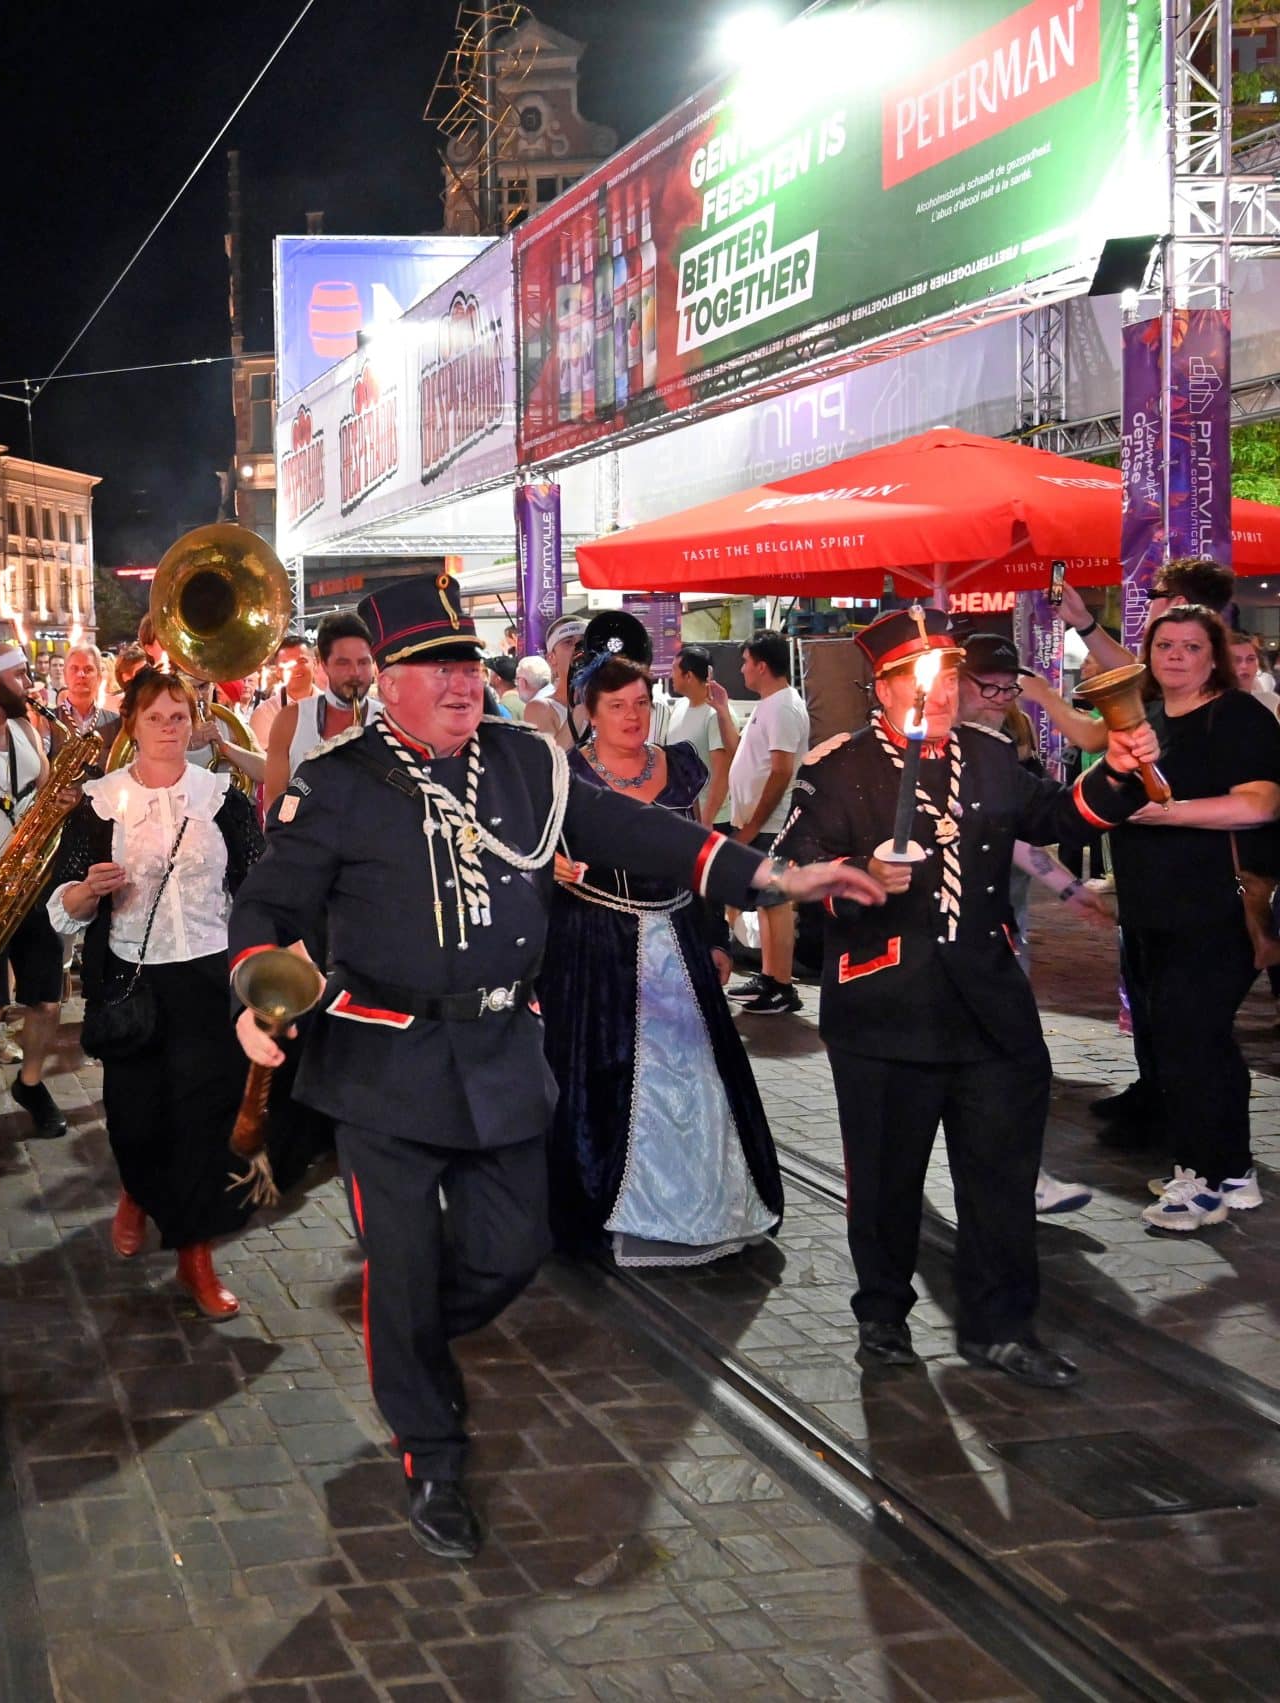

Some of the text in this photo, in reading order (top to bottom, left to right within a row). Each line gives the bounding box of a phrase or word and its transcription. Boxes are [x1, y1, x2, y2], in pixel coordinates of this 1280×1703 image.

[896, 5, 1076, 161] PETERMAN
[701, 110, 847, 232] FEESTEN IS
[915, 182, 967, 215] Alcoholmisbruik
[967, 167, 995, 190] schaadt
[995, 164, 1005, 177] de
[931, 205, 952, 223] L'abus
[953, 191, 980, 213] d'alcool
[980, 185, 995, 201] nuit
[1001, 180, 1009, 190] la
[681, 220, 768, 299] BETTER
[930, 245, 1019, 291] #BETTERTOGETHER
[684, 248, 811, 342] TOGETHER
[852, 280, 928, 322] #BETTERTOGETHER
[1132, 412, 1147, 484] Gentse
[683, 534, 866, 562] TASTE THE BELGIAN SPIRIT
[949, 591, 1017, 614] HEMA
